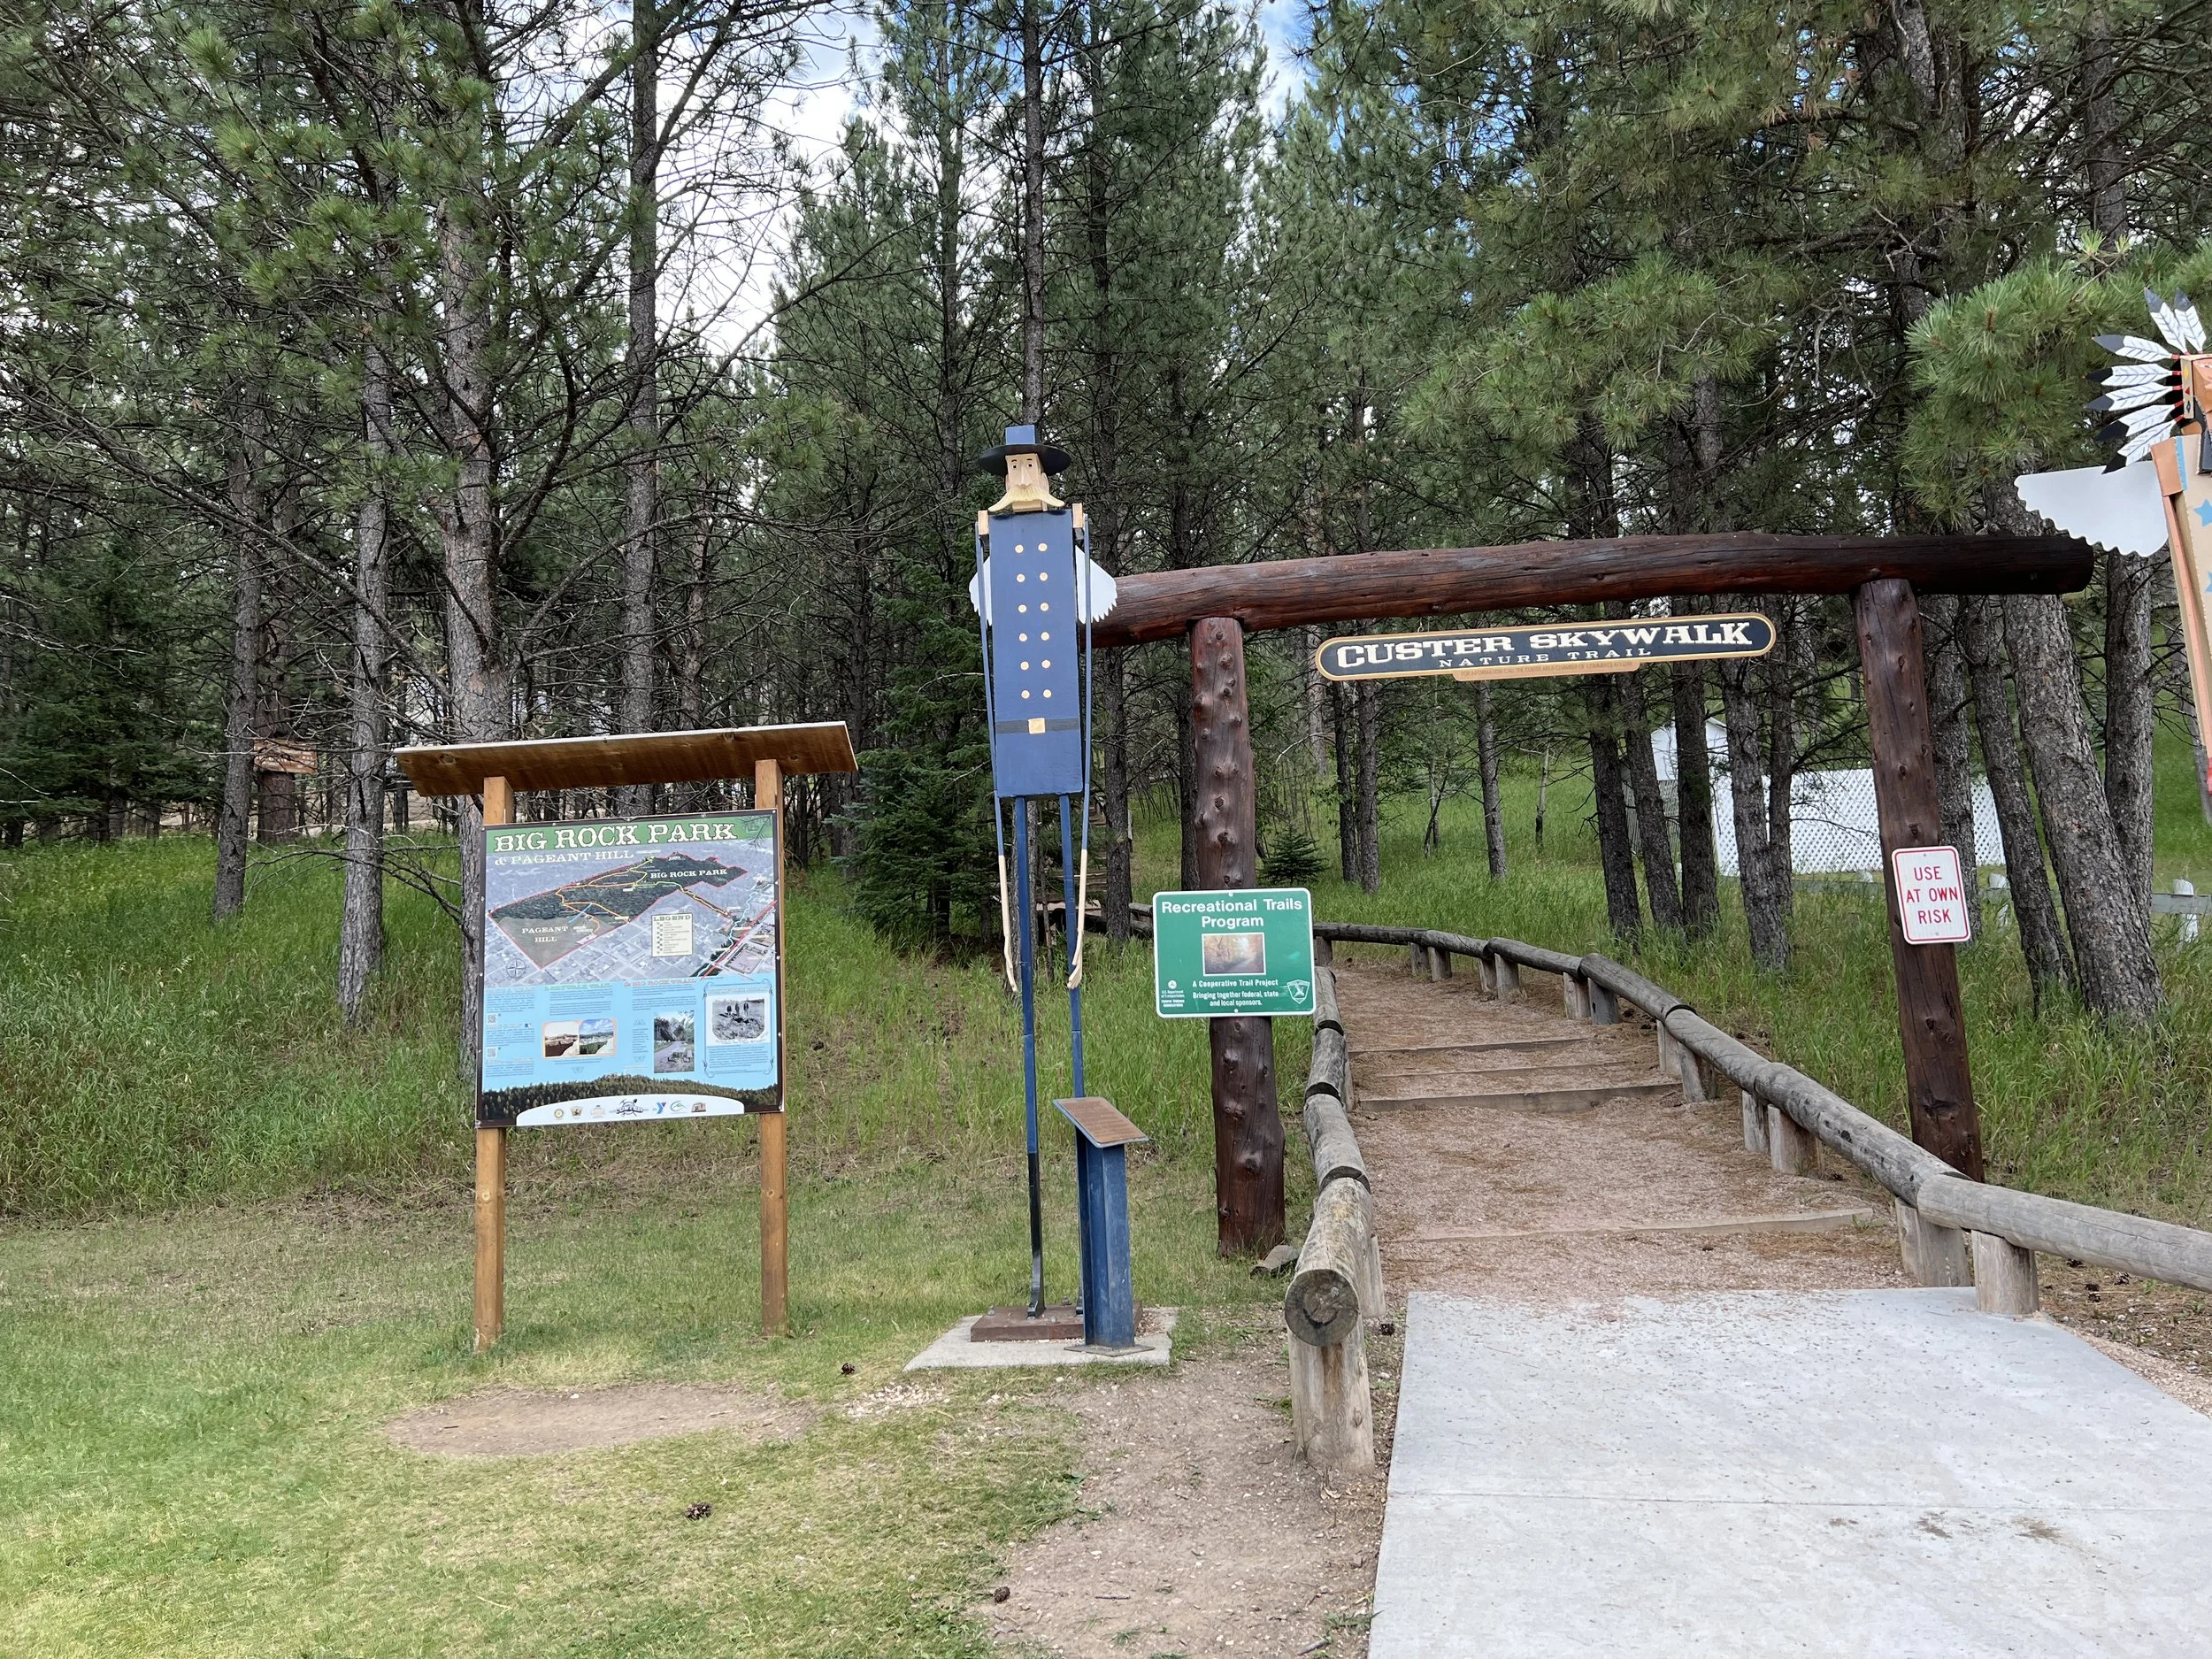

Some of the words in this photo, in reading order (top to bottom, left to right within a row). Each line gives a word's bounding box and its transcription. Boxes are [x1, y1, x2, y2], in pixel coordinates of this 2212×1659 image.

[1337, 636, 1515, 668] CUSTER
[1530, 622, 1752, 649] SKYWALK
[1439, 653, 1549, 668] NATURE
[1568, 648, 1651, 660] TRAIL
[495, 832, 548, 852] BIG
[555, 826, 641, 849] ROCK
[648, 822, 737, 843] PARK
[511, 852, 591, 865] PAGEANT
[595, 849, 634, 861] HILL
[1914, 866, 1942, 880] USE
[1906, 889, 1921, 902] AT
[1929, 887, 1958, 902] OWN
[1161, 899, 1257, 913] Recreational
[1263, 898, 1303, 910] Trails
[1202, 916, 1264, 930] Program
[1918, 909, 1952, 924] RISK
[1199, 979, 1237, 988] Cooperative
